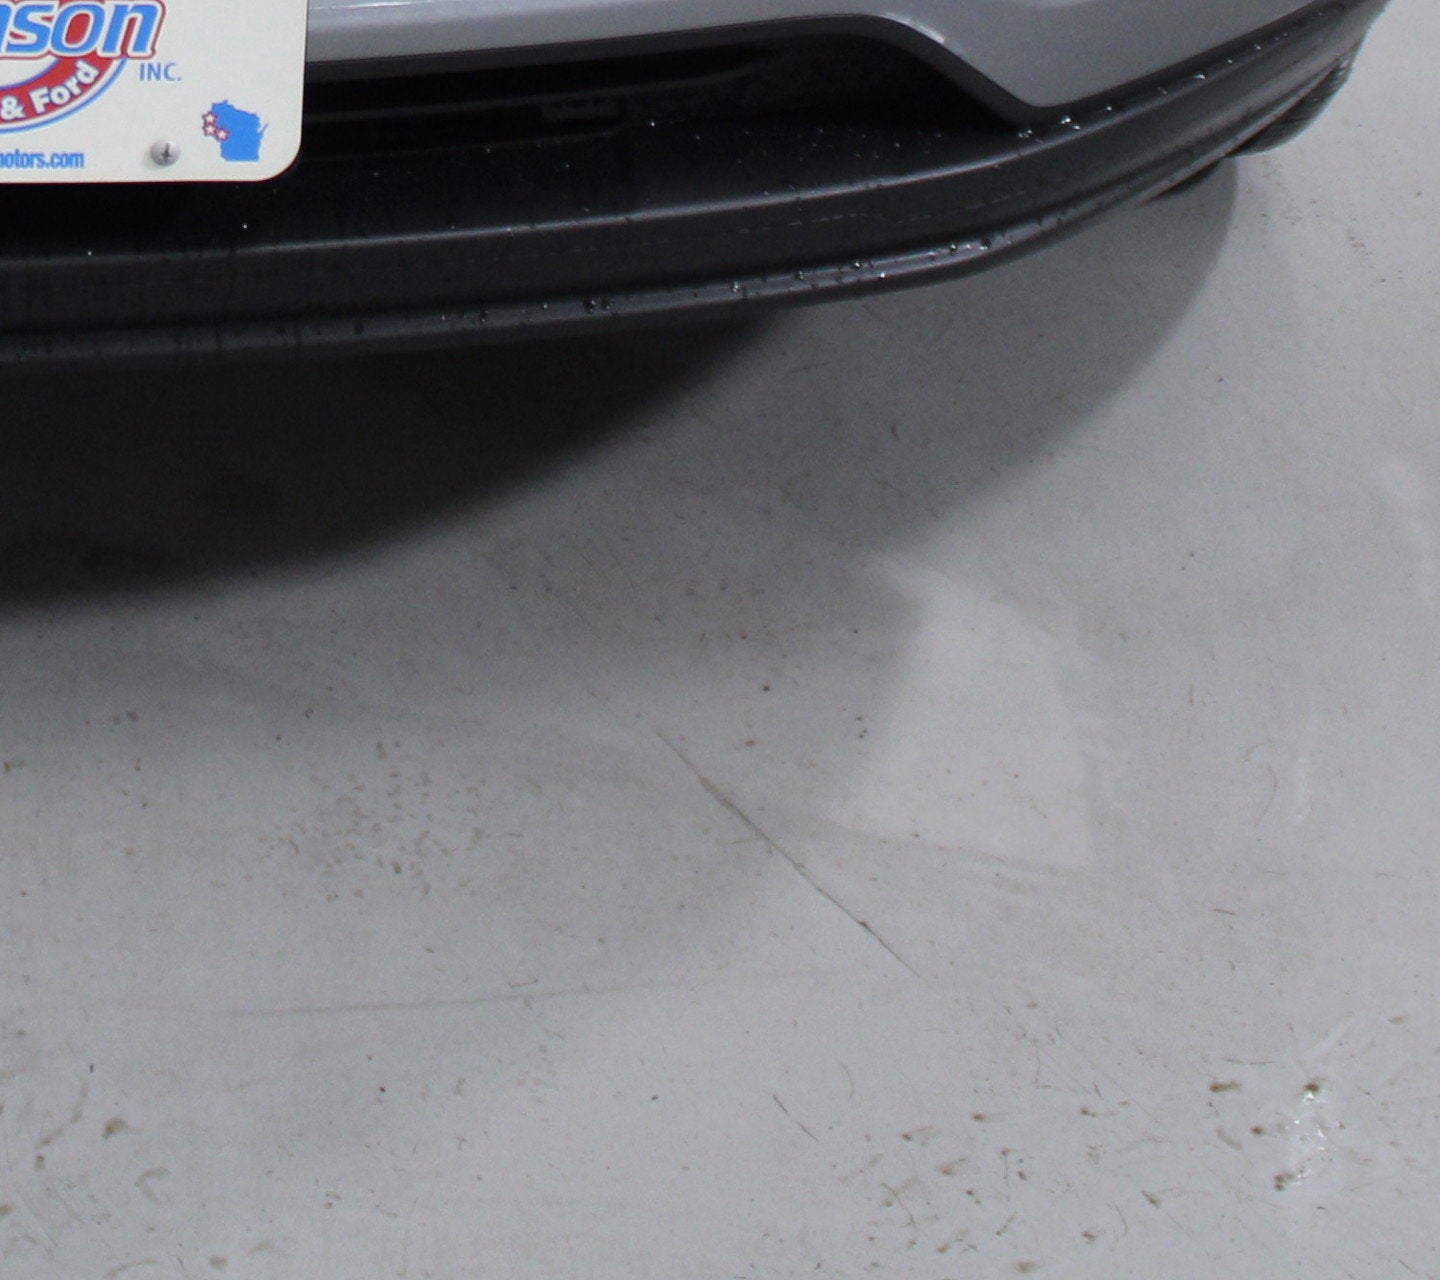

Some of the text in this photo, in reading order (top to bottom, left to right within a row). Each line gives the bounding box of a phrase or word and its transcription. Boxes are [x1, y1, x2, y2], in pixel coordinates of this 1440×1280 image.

[0, 95, 26, 122] &
[29, 60, 101, 114] Ford
[139, 63, 182, 82] INC.
